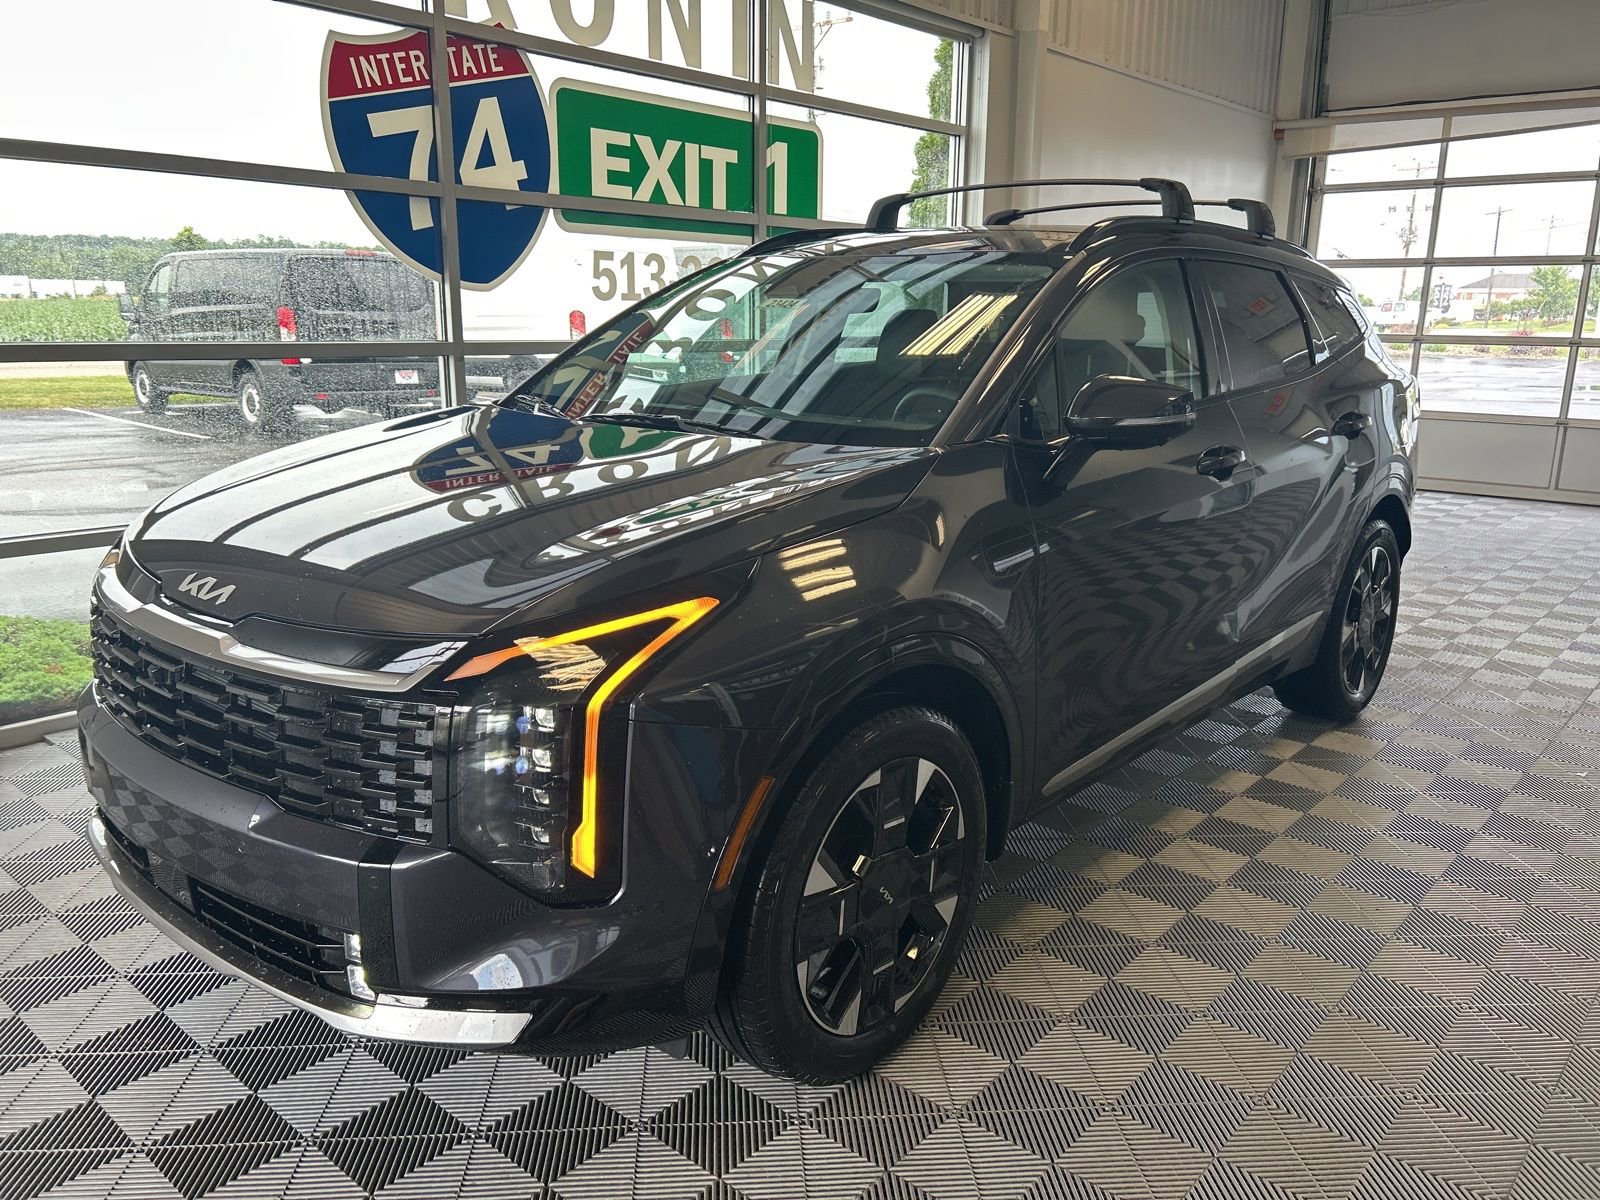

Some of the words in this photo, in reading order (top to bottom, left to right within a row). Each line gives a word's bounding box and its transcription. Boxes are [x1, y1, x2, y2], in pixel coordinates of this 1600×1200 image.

[350, 44, 503, 88] INTERTATE
[444, 0, 812, 92] NIN
[366, 97, 528, 231] 74
[591, 127, 738, 210] EXIT
[766, 141, 788, 215] 1
[178, 572, 236, 605] KIA
